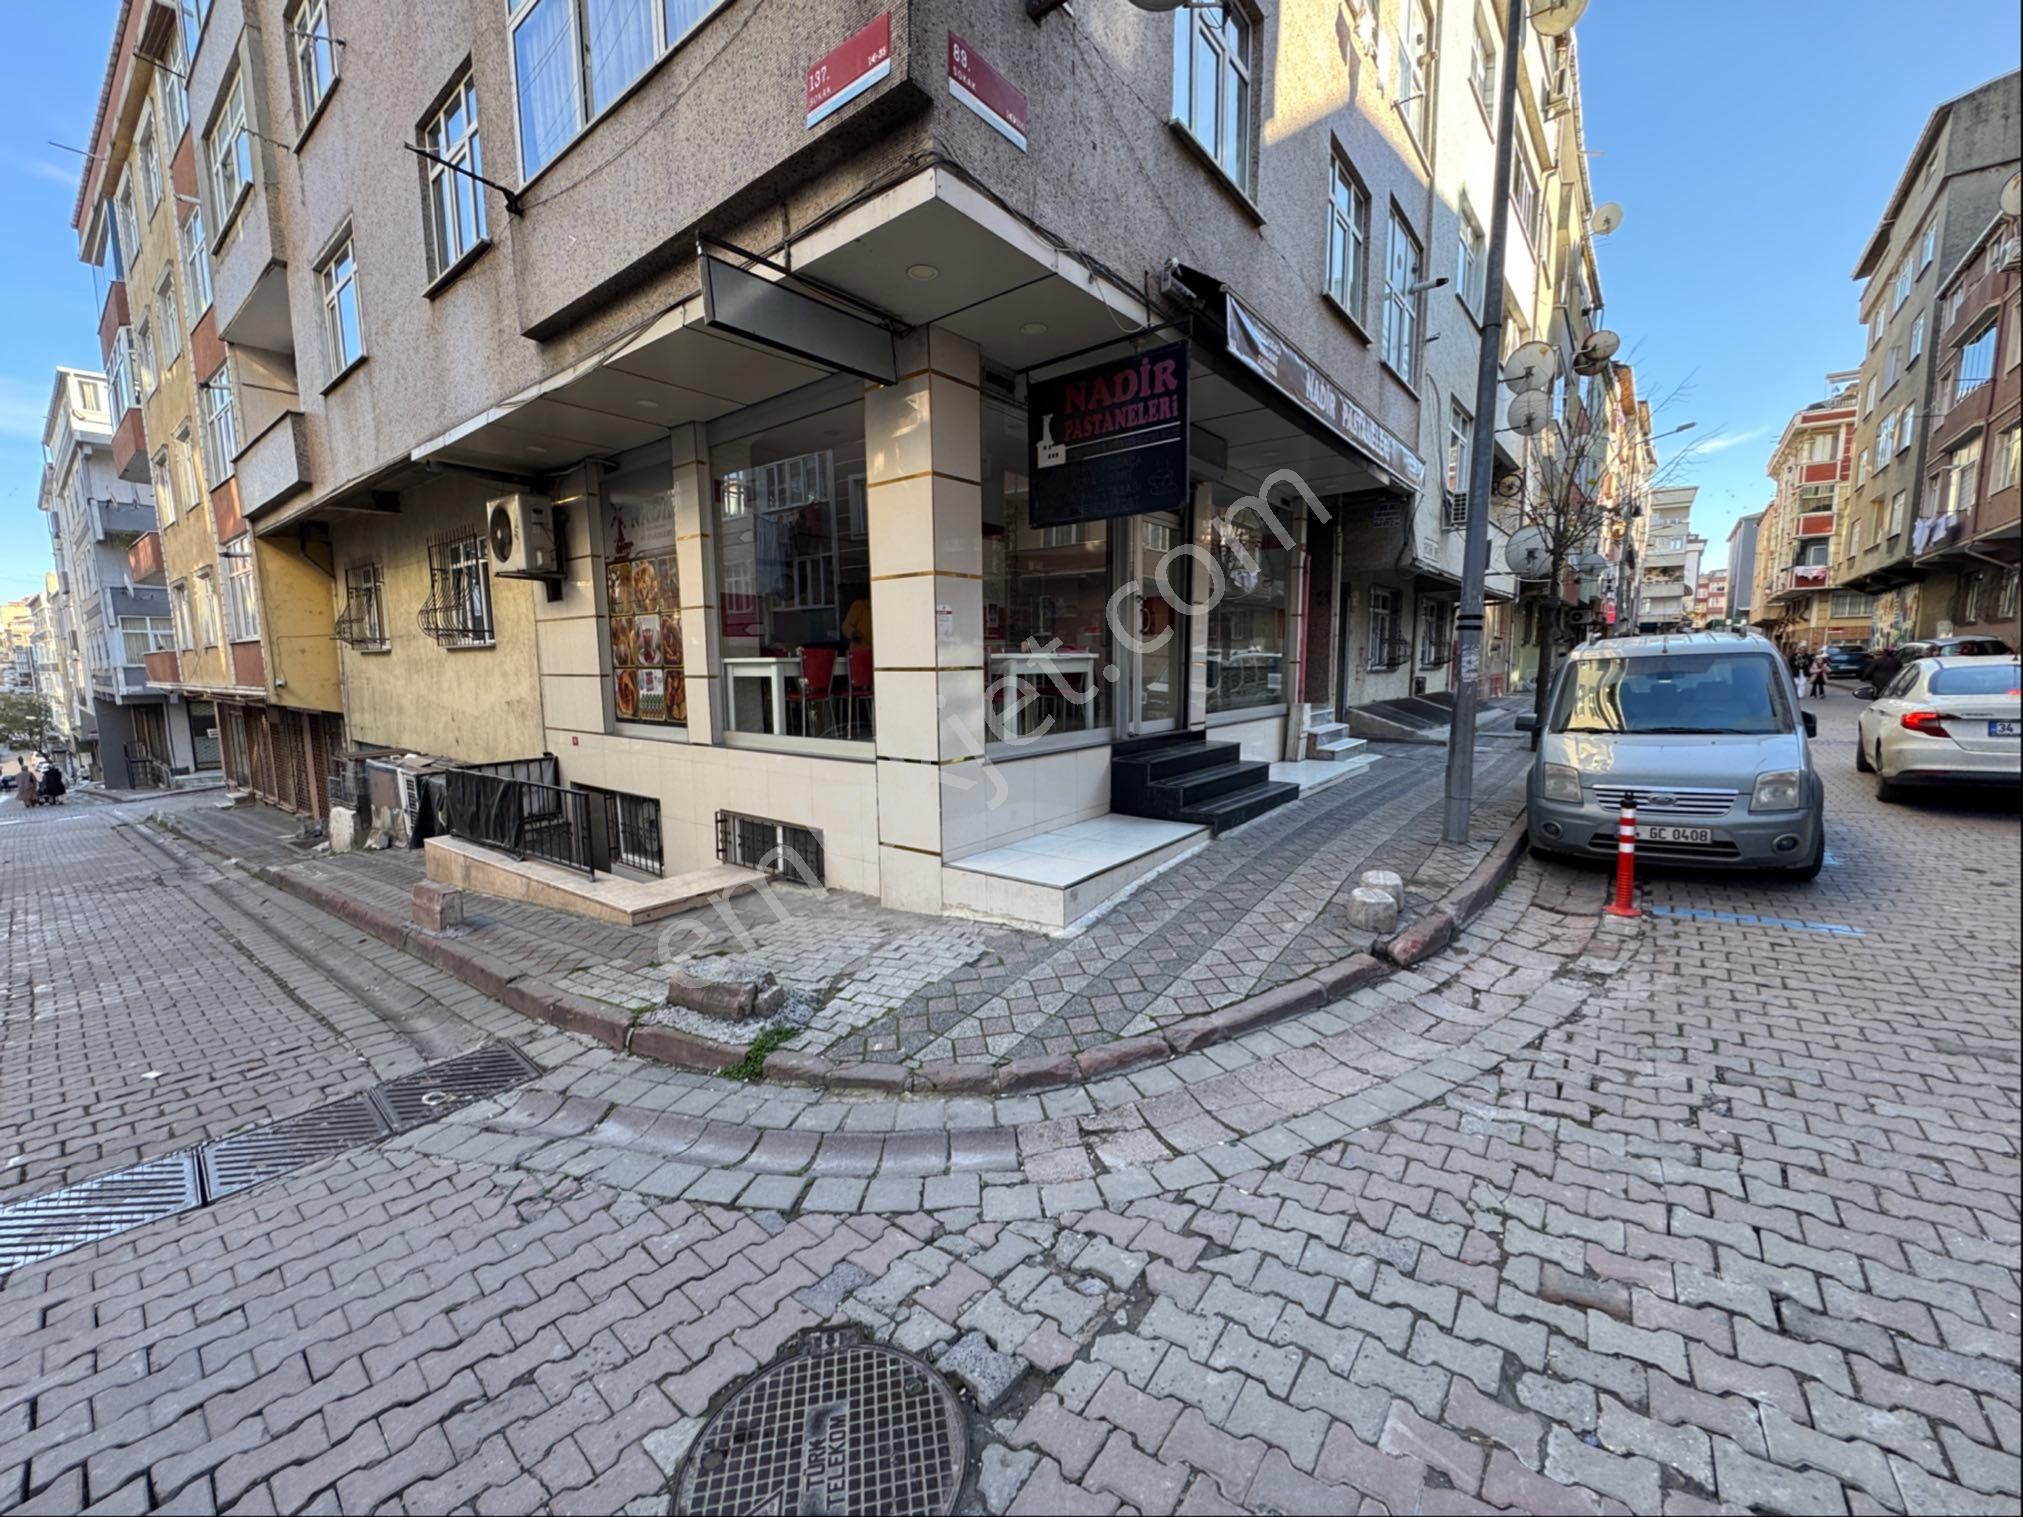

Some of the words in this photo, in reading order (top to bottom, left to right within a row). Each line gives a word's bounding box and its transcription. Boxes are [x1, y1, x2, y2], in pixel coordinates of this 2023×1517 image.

[1064, 356, 1178, 415] NADİR
[1649, 827, 1667, 840] GC
[1672, 828, 1708, 842] 0408
[826, 1413, 846, 1511] TELEKOM
